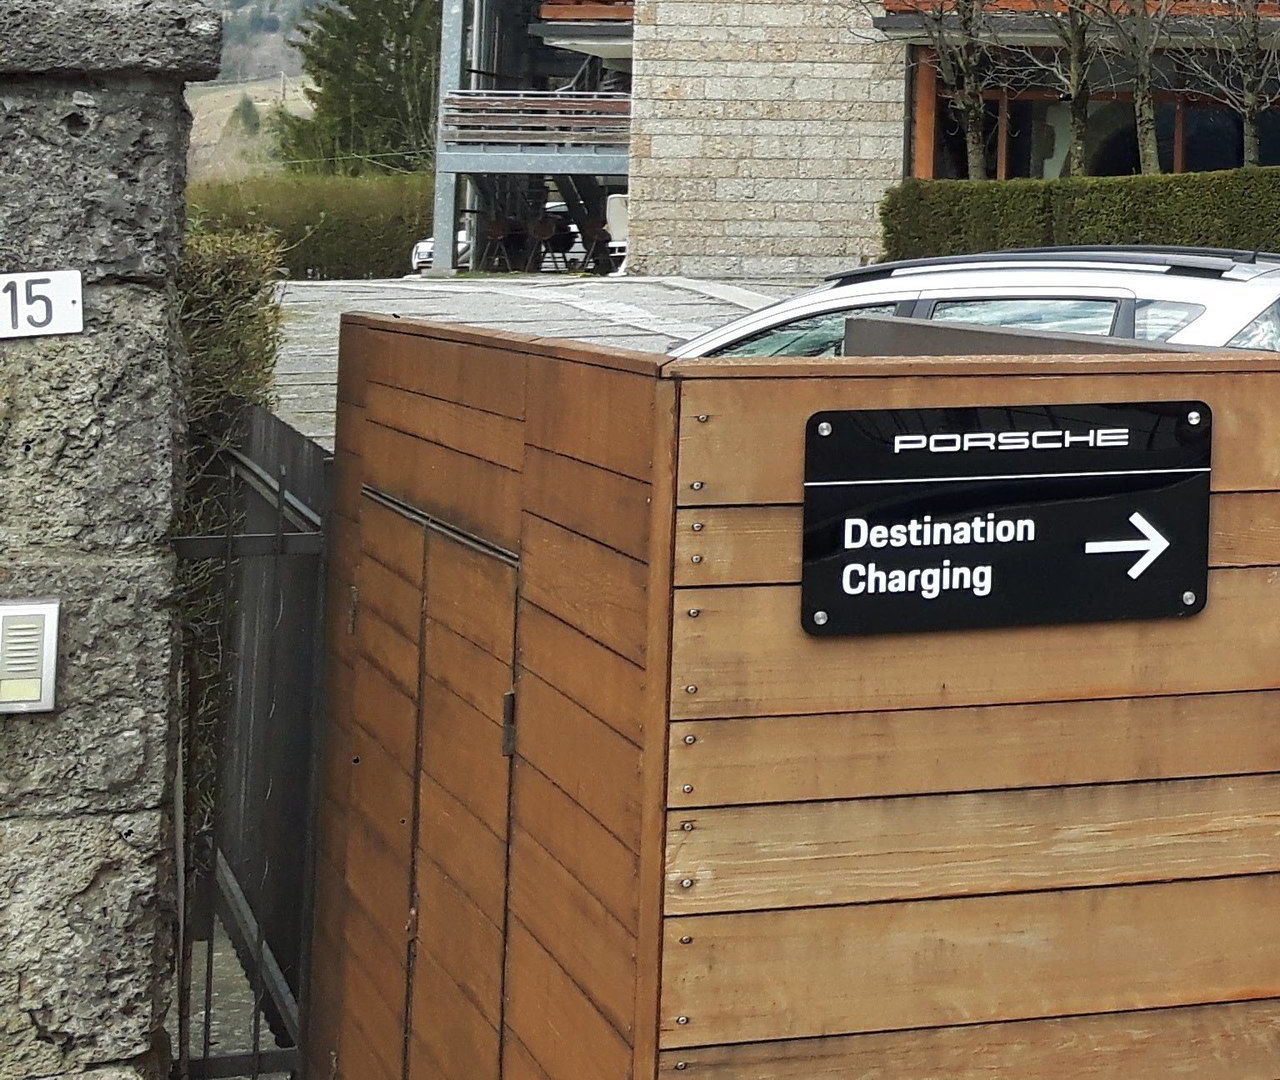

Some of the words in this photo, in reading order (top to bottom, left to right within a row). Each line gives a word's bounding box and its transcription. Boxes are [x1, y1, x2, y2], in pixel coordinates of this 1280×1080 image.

[2, 278, 53, 330] 15
[894, 428, 1130, 454] PORSCHE
[844, 512, 1035, 549] Destination
[842, 559, 992, 599] Charging
